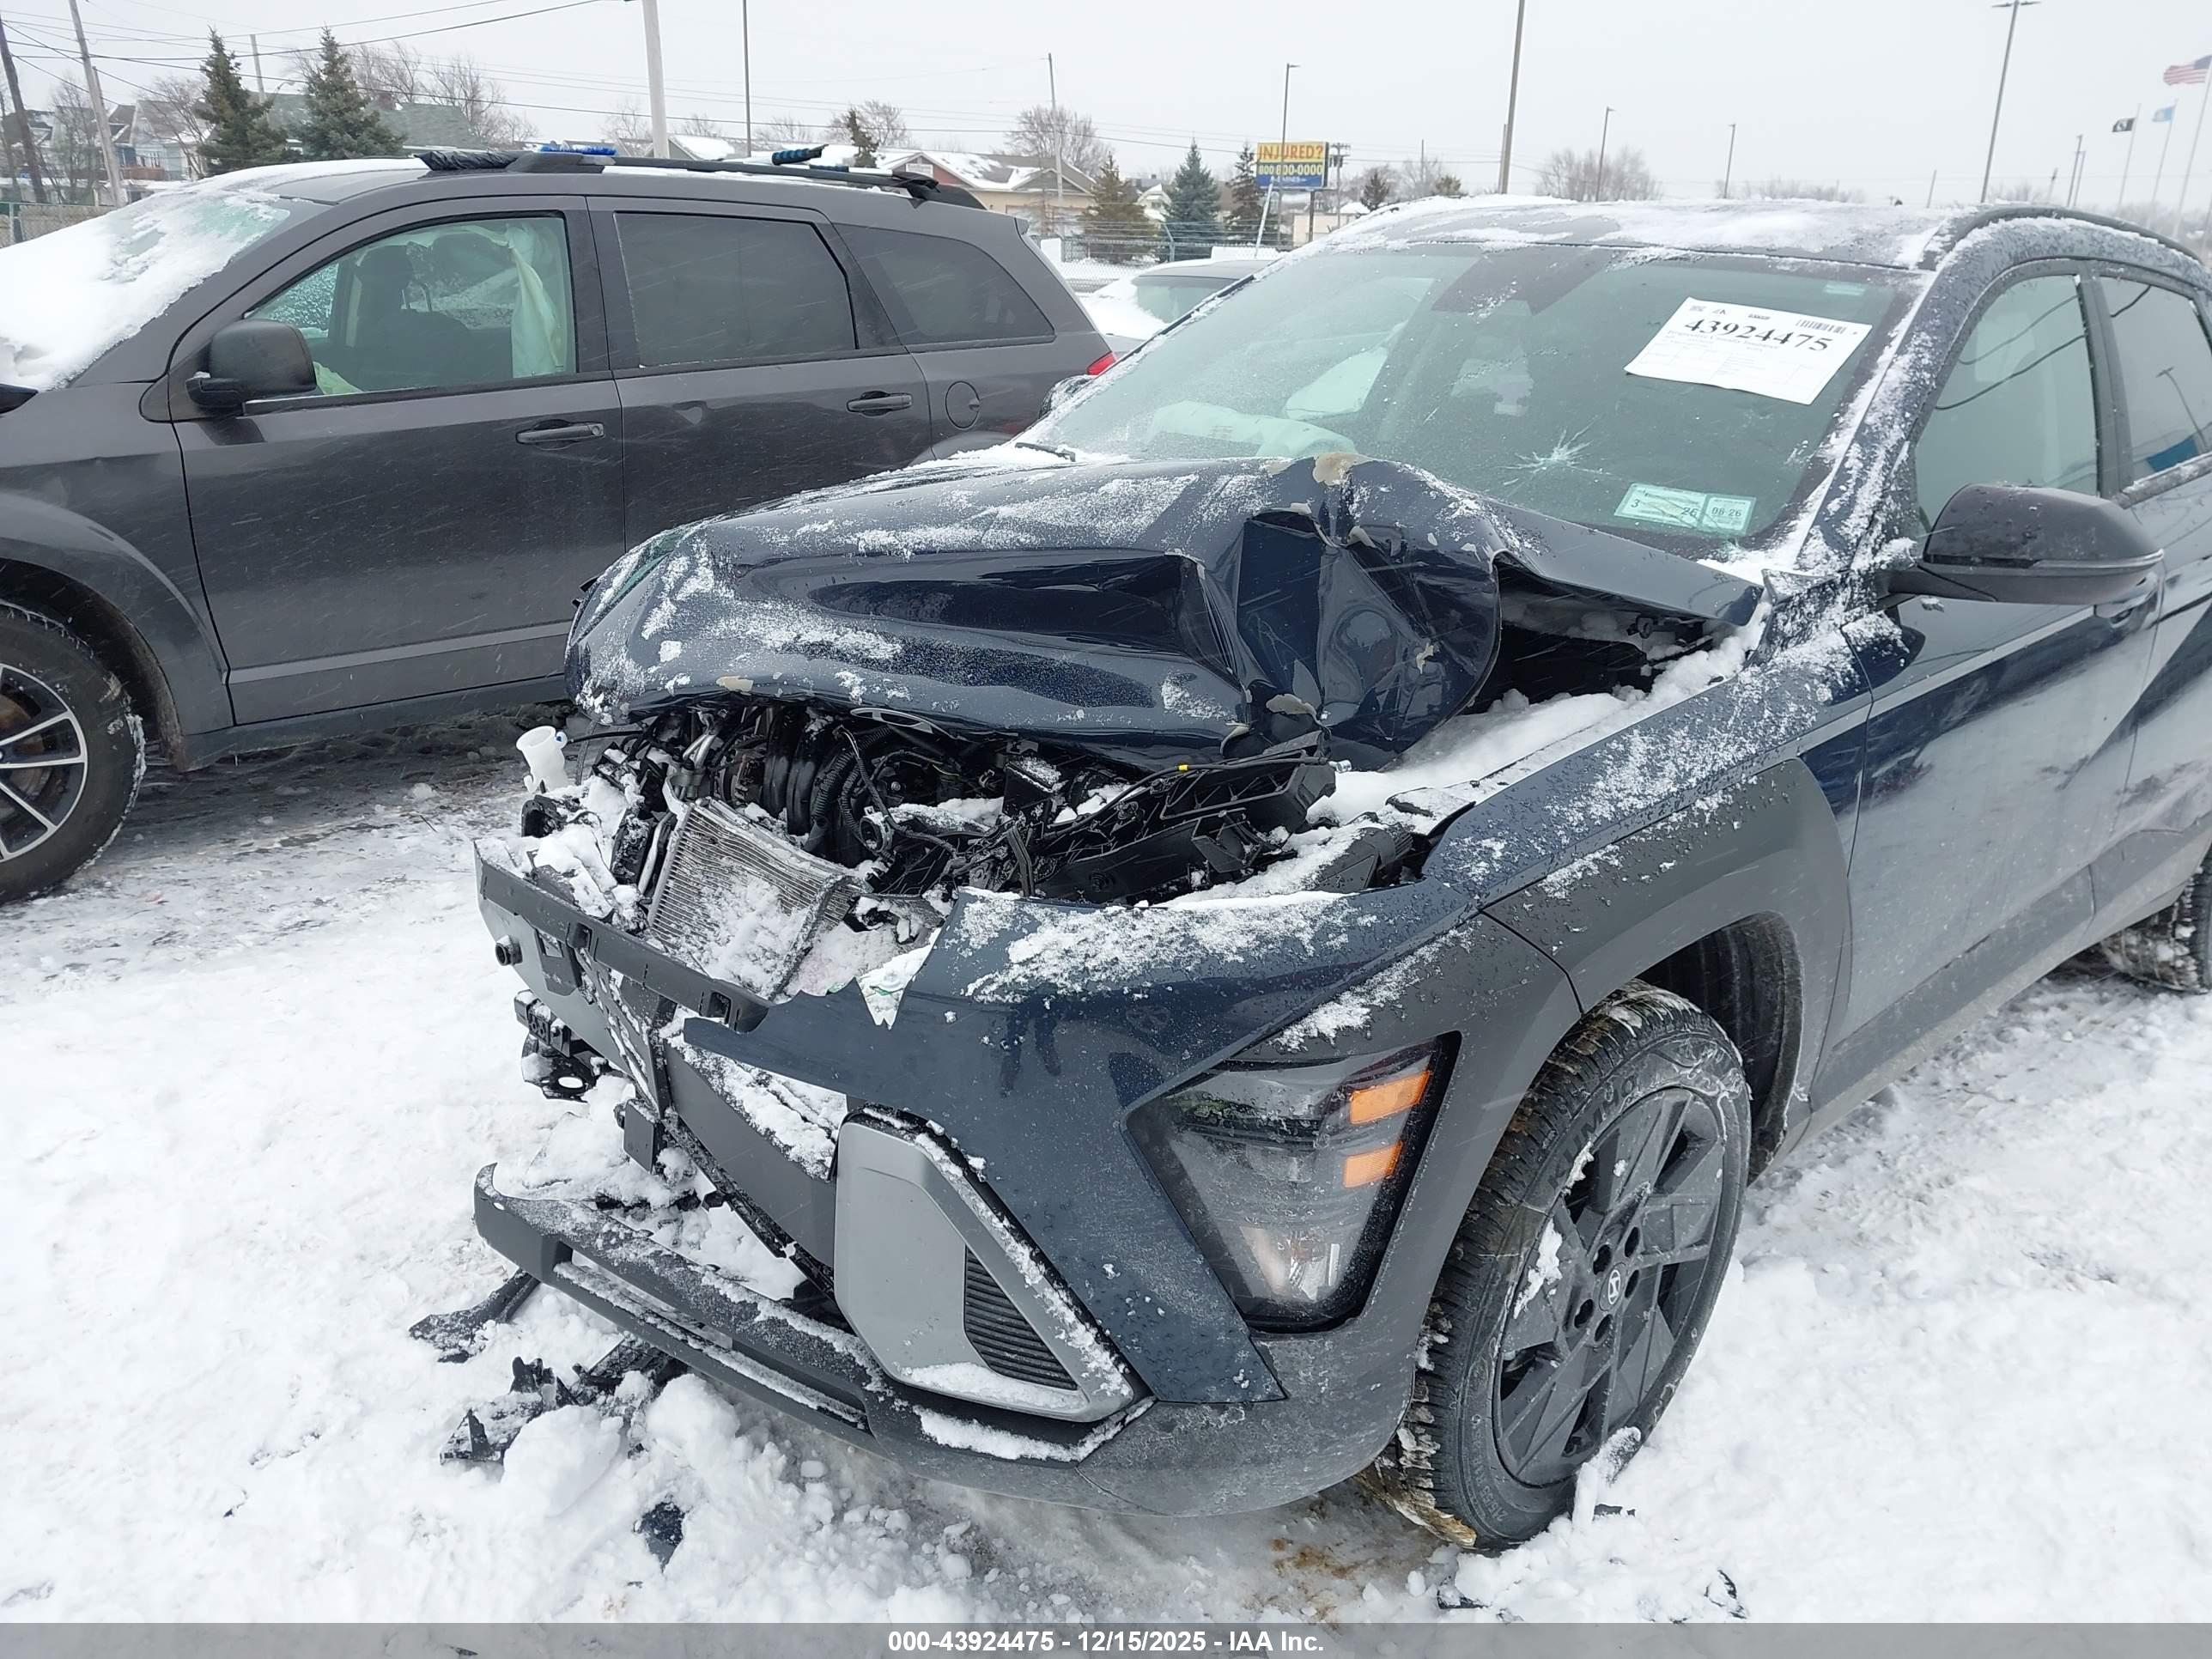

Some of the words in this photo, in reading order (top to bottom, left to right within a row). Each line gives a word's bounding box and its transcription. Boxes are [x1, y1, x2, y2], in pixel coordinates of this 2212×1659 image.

[1258, 143, 1323, 160] INJURED?
[1683, 318, 1834, 352] 43924475
[1630, 498, 1641, 508] 3
[1547, 1074, 1637, 1188] KUMHO
